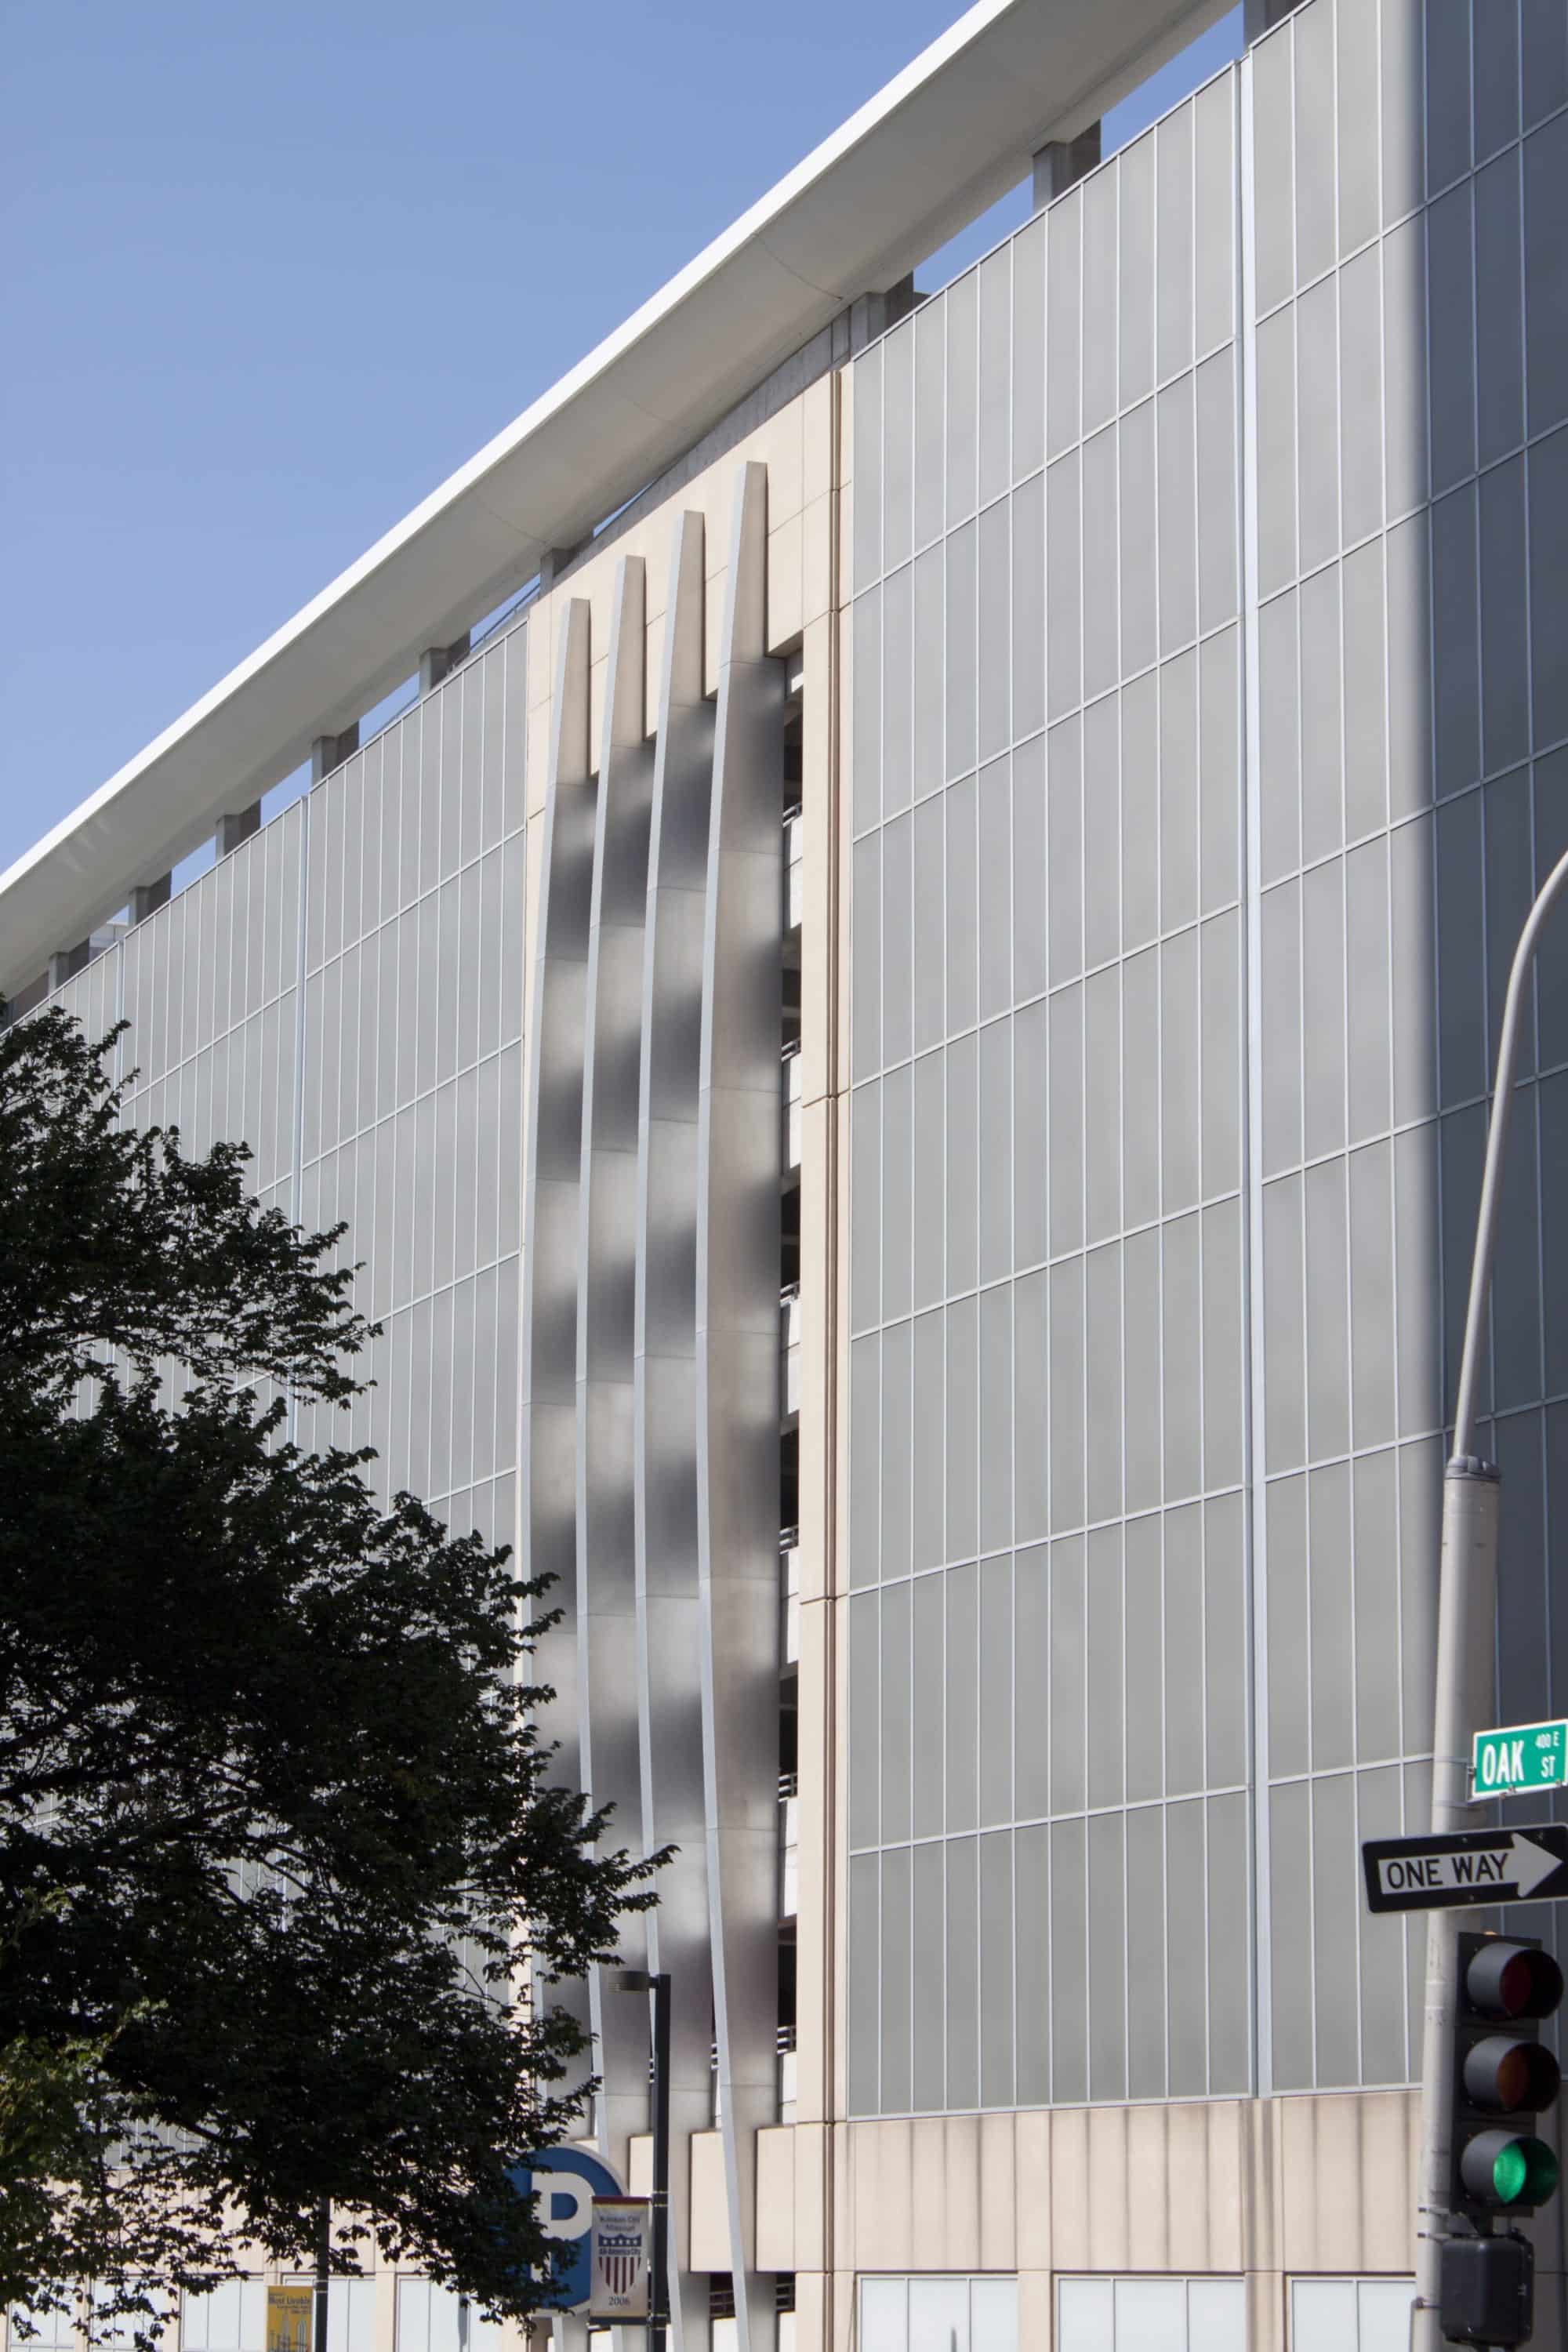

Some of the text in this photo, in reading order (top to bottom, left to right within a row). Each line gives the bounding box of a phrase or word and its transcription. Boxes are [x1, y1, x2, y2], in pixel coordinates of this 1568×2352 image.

[1535, 1730, 1559, 1749] 400 E
[1483, 1740, 1525, 1786] OAK
[1541, 1755, 1555, 1778] ST
[1387, 1853, 1508, 1889] ONE WAY
[531, 2171, 595, 2282] P
